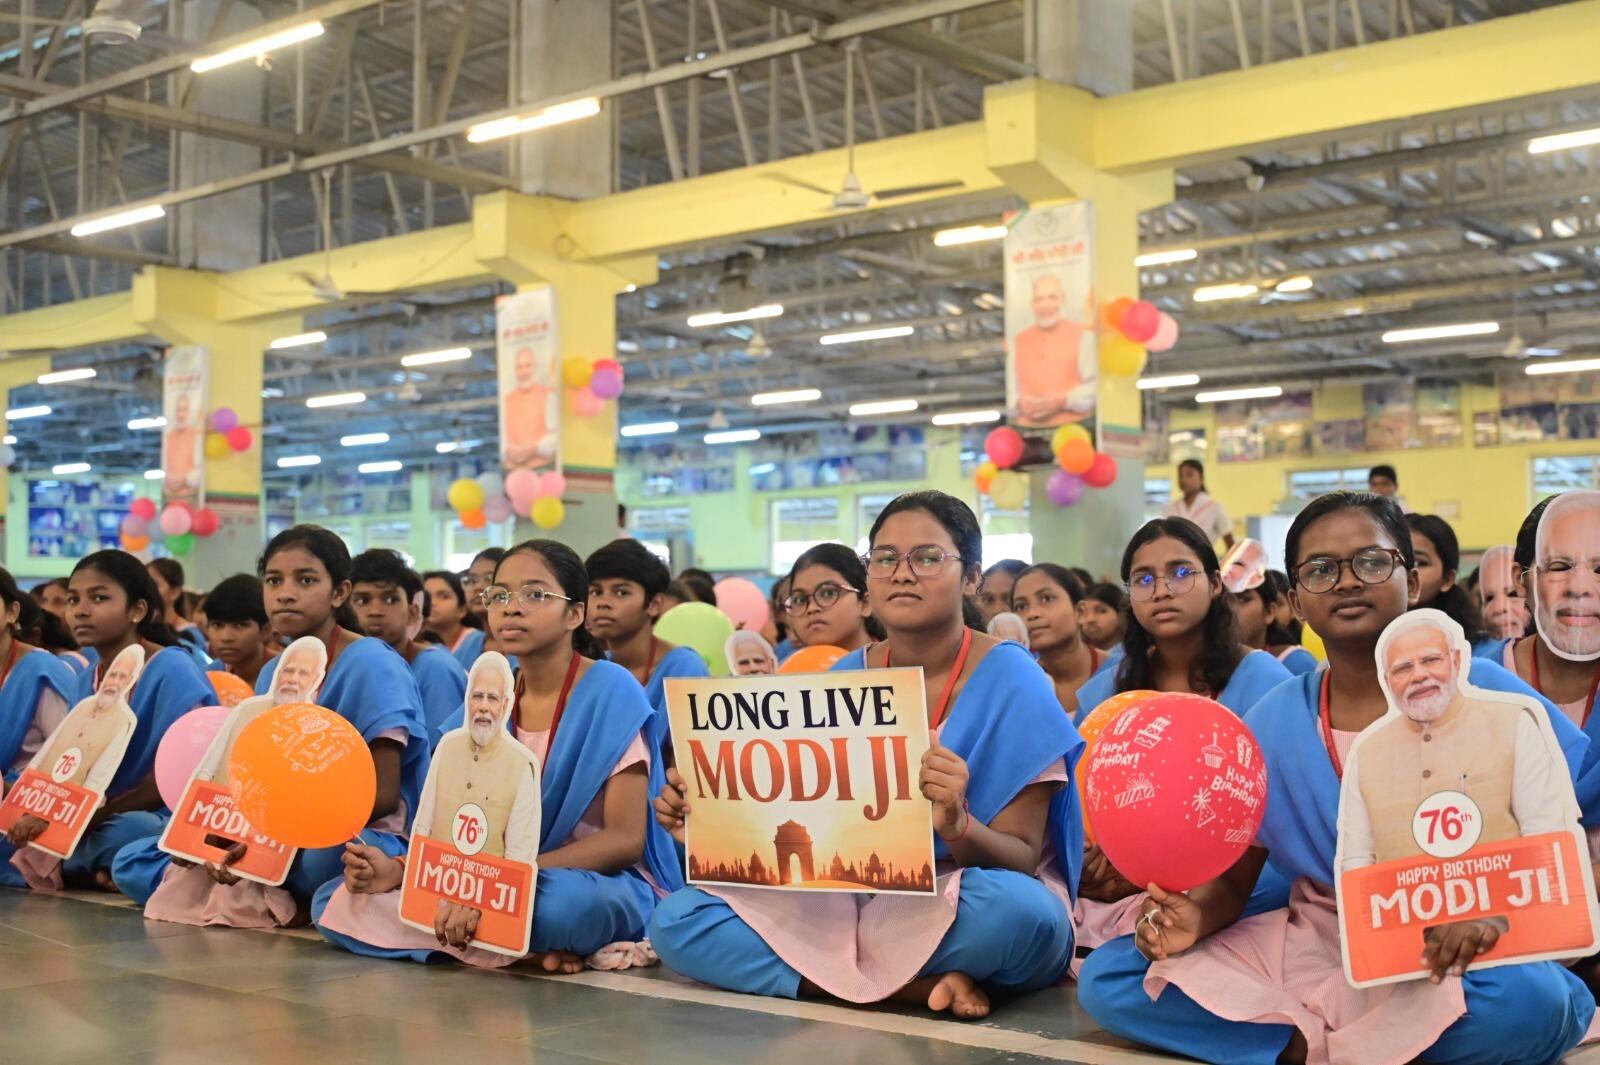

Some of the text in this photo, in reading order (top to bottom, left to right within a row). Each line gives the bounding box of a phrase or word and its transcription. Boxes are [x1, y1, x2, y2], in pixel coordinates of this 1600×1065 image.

[687, 686, 897, 731] LONG LIVE
[1100, 741, 1130, 757] HAPPY
[687, 735, 913, 822] MODI JI
[1210, 774, 1259, 815] BIRTHDAY!
[1225, 765, 1256, 792] HAPPY
[12, 785, 77, 824] MODI JI
[188, 800, 251, 838] MODI
[457, 814, 484, 845] 76th
[1420, 806, 1472, 844] 76th
[440, 851, 501, 880] HAPPY BIRTHDAY
[1396, 853, 1513, 888] HAPPY BIRTHDAY
[421, 861, 517, 913] MODI JI
[1369, 867, 1551, 929] MODI JI
